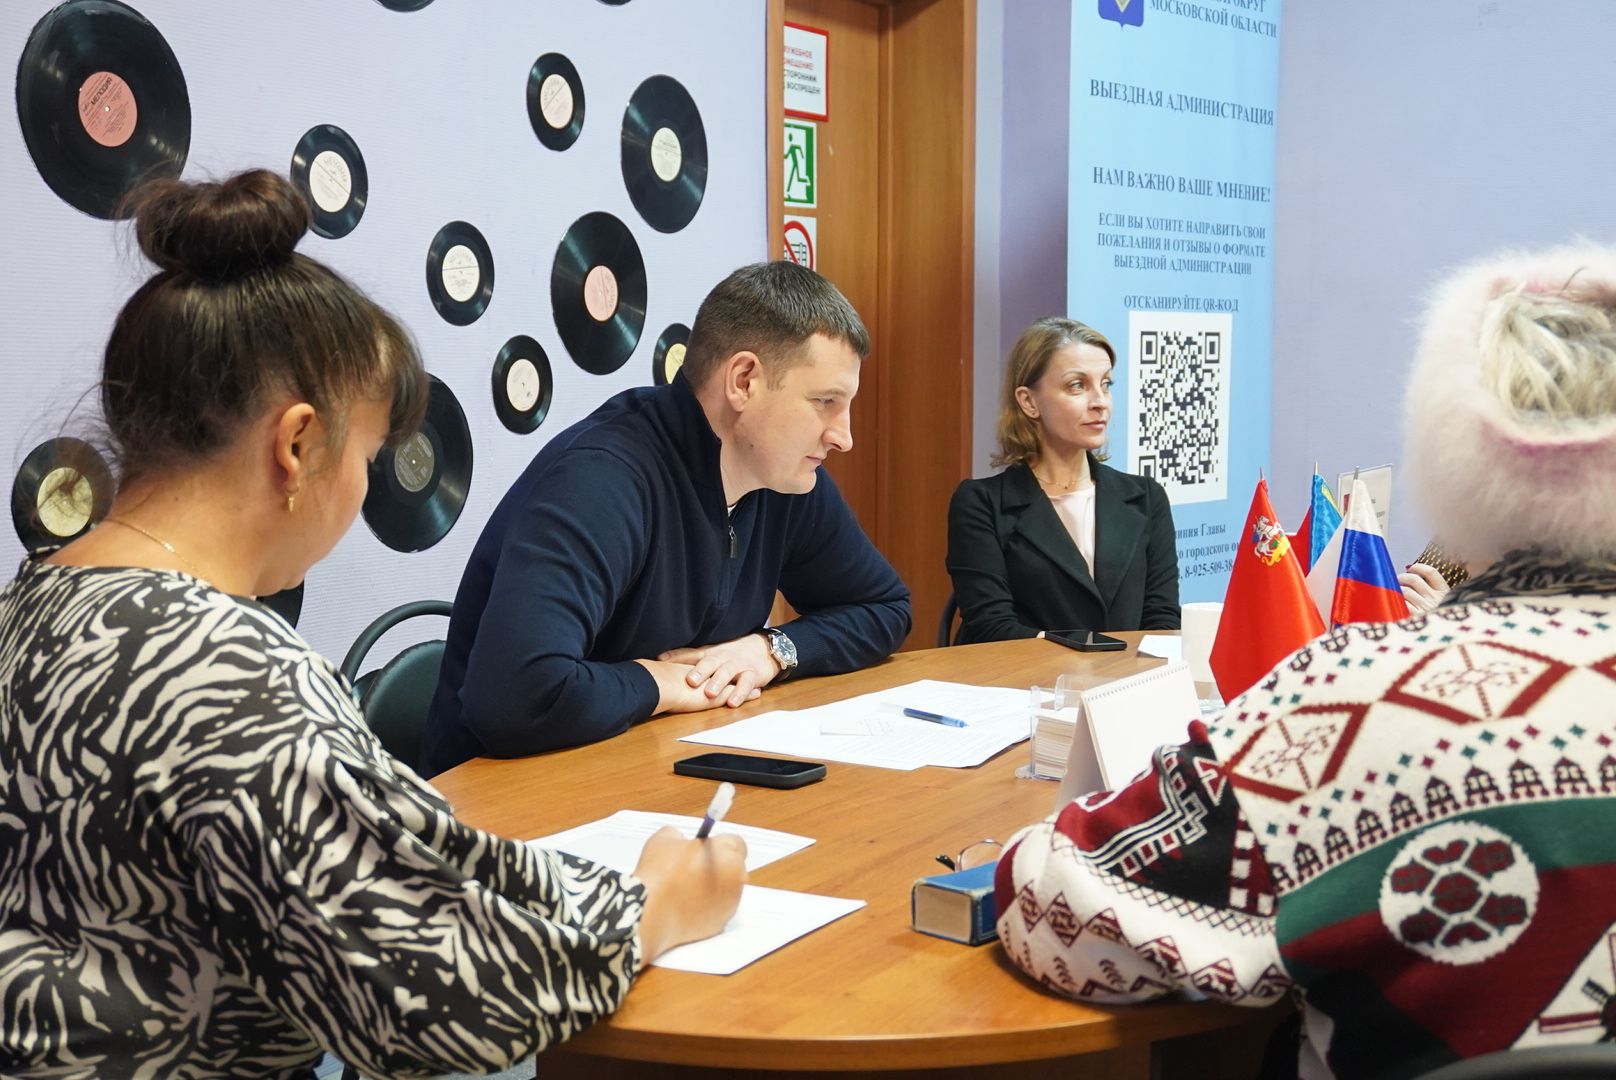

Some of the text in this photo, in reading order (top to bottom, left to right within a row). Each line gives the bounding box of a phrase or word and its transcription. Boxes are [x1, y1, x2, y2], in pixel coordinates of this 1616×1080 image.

[1150, 0, 1277, 38] МОСКОВСКОЙ ОБЛАСТИ
[1090, 79, 1275, 127] ВЫЕЗДНАЯ АДМИНИСТРАЦИЯ
[1093, 166, 1271, 203] НАМ ВАЖНО ВАШЕ МНЕНИЕ!
[1099, 212, 1266, 239] ЕСЛИ ВЫ ХОТИТЕ НАПРАВИТЬ СВОИ
[1097, 233, 1266, 258] ПОЖЕЛАНИЯ И ОТЗЫВЫ О ФОРМАТЕ
[1114, 255, 1252, 275] ВЫЕЗДНОЙ АДМИНИСТРАЦИИ
[1124, 294, 1239, 312] ОТСКАНИРУЙТЕ QR-КОД
[1201, 523, 1226, 536] Главы
[1186, 544, 1230, 560] городского
